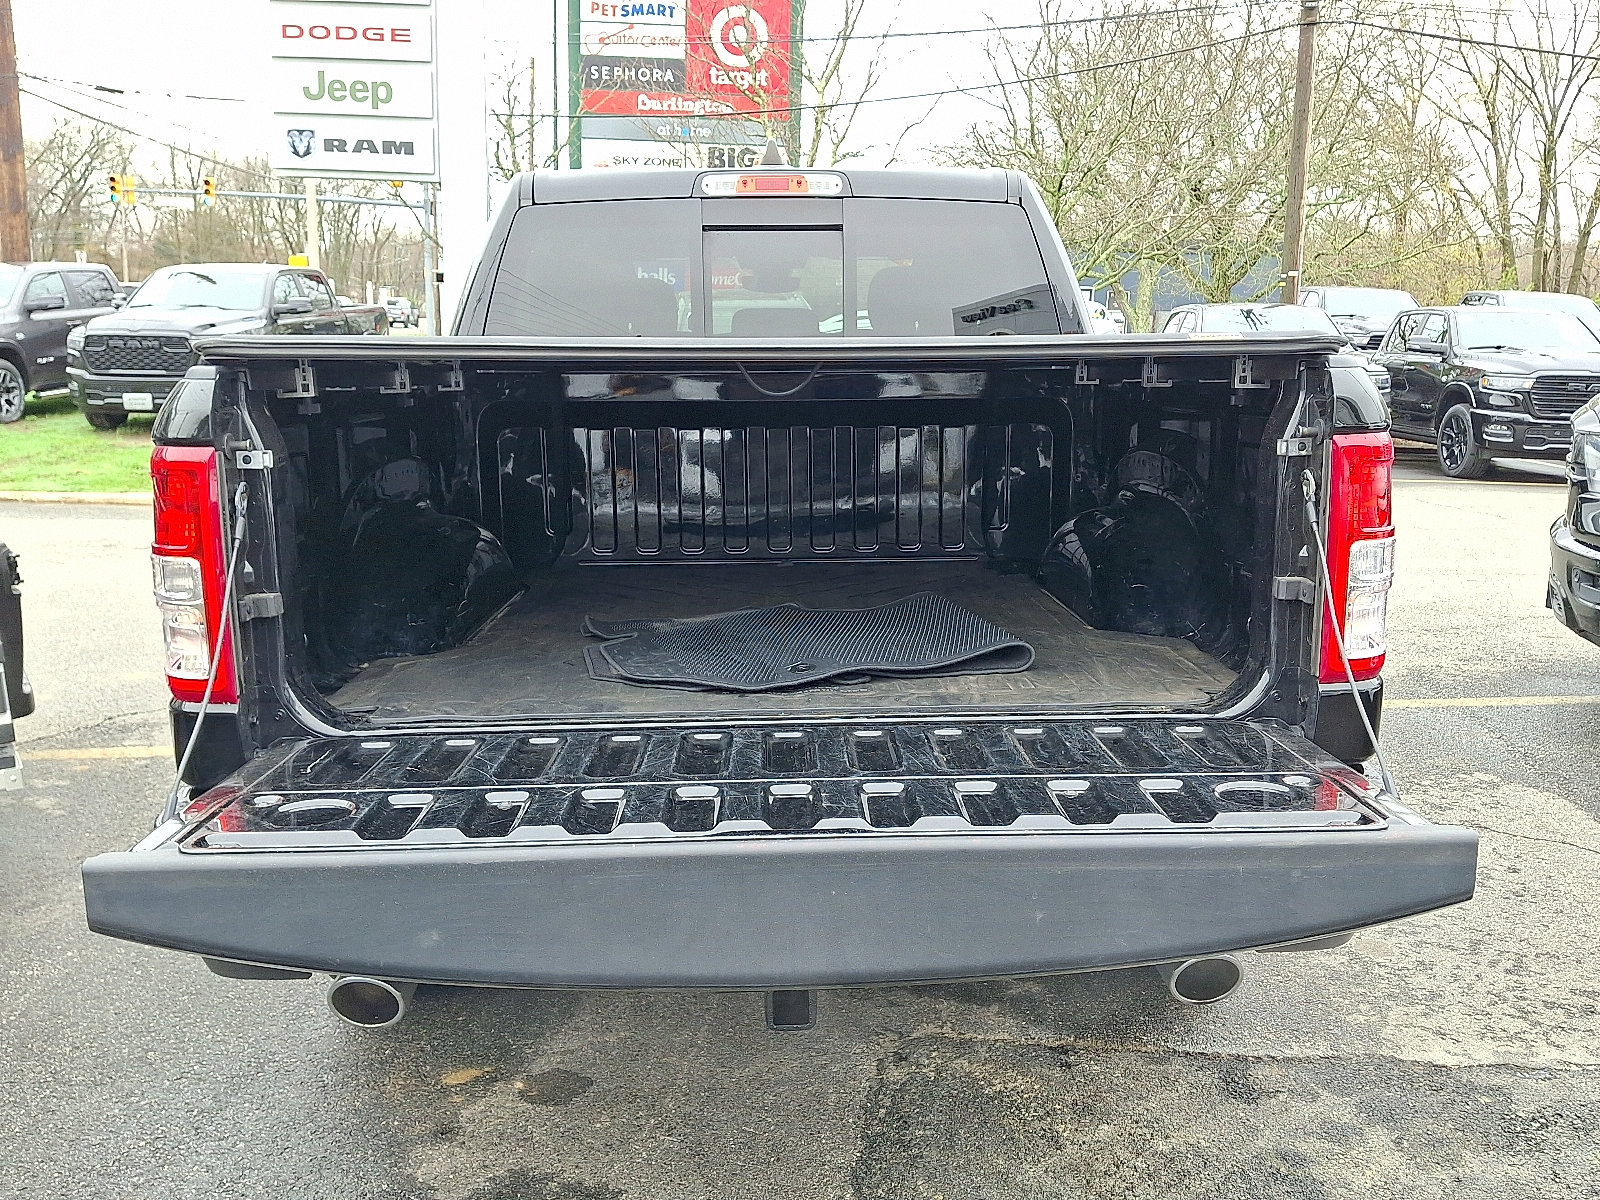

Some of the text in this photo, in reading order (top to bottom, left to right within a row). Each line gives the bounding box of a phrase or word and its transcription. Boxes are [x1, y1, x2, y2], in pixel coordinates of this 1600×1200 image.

[281, 24, 412, 43] DODGE
[590, 65, 675, 83] SEPHORA
[302, 70, 393, 110] Jeep
[637, 93, 735, 116] Burlington
[656, 124, 671, 137] at
[323, 138, 415, 156] RAM
[612, 155, 683, 168] SKY ZONE
[707, 146, 759, 168] BIG
[107, 338, 162, 349] RAM
